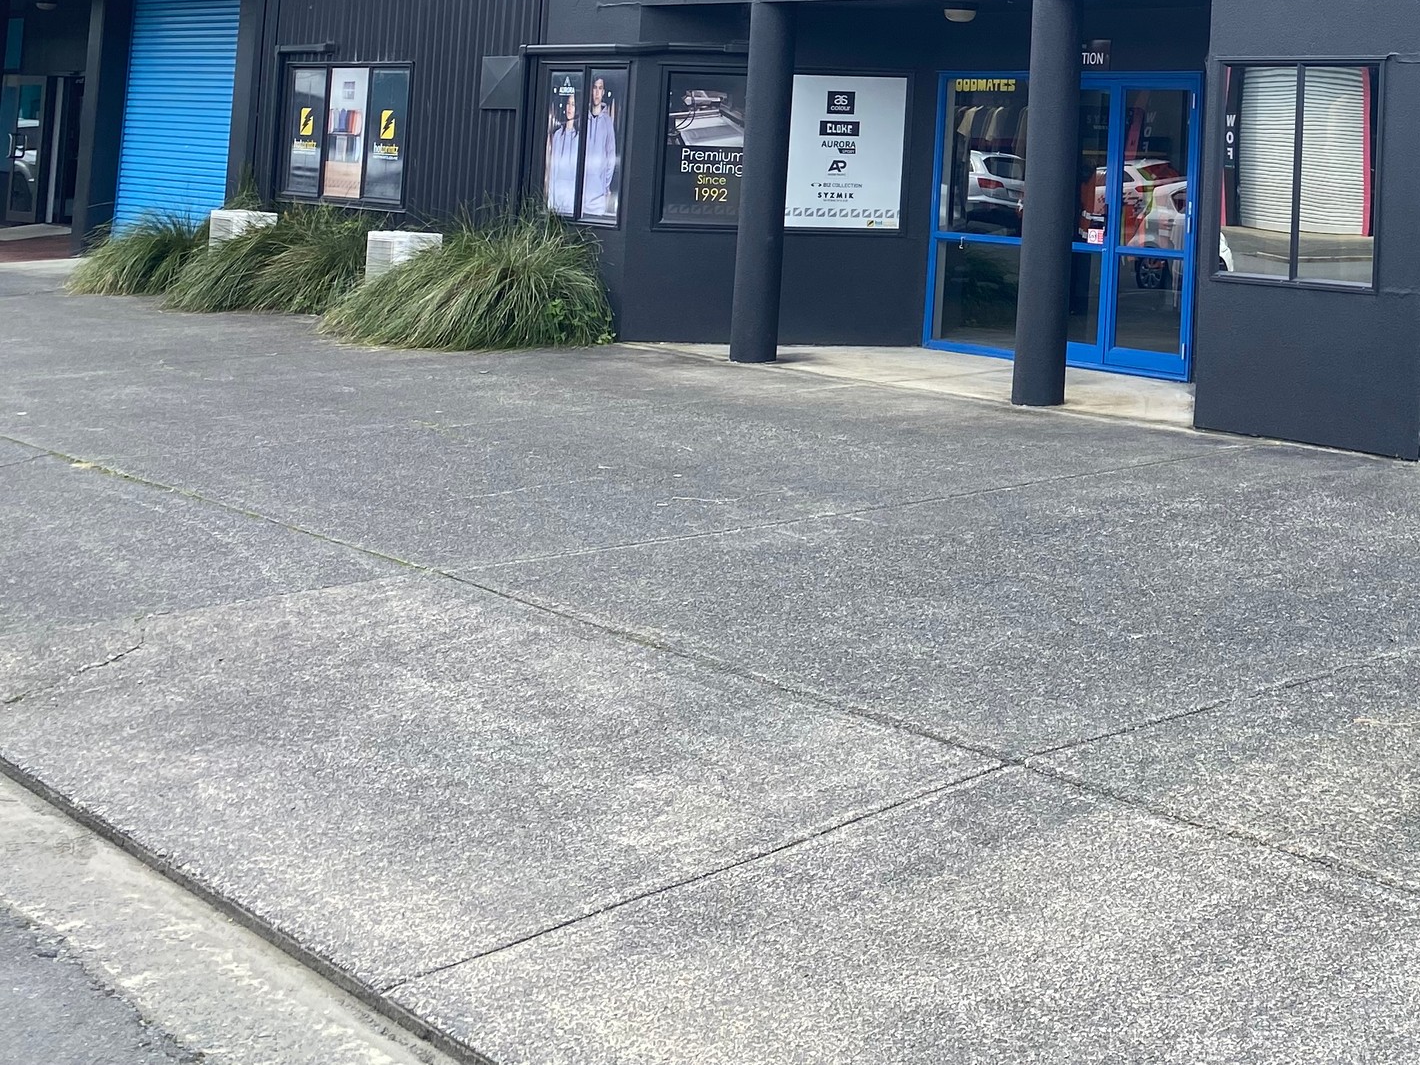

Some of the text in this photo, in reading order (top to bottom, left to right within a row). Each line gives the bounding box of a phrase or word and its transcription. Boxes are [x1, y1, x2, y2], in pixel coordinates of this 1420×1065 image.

[1081, 52, 1104, 65] TION
[955, 78, 1016, 92] OODMATES
[821, 140, 856, 148] AURORA
[681, 147, 744, 163] Premium
[680, 160, 743, 177] Branding
[697, 174, 727, 185] Since
[694, 187, 728, 202] 1992
[817, 191, 855, 199] SYZMIK
